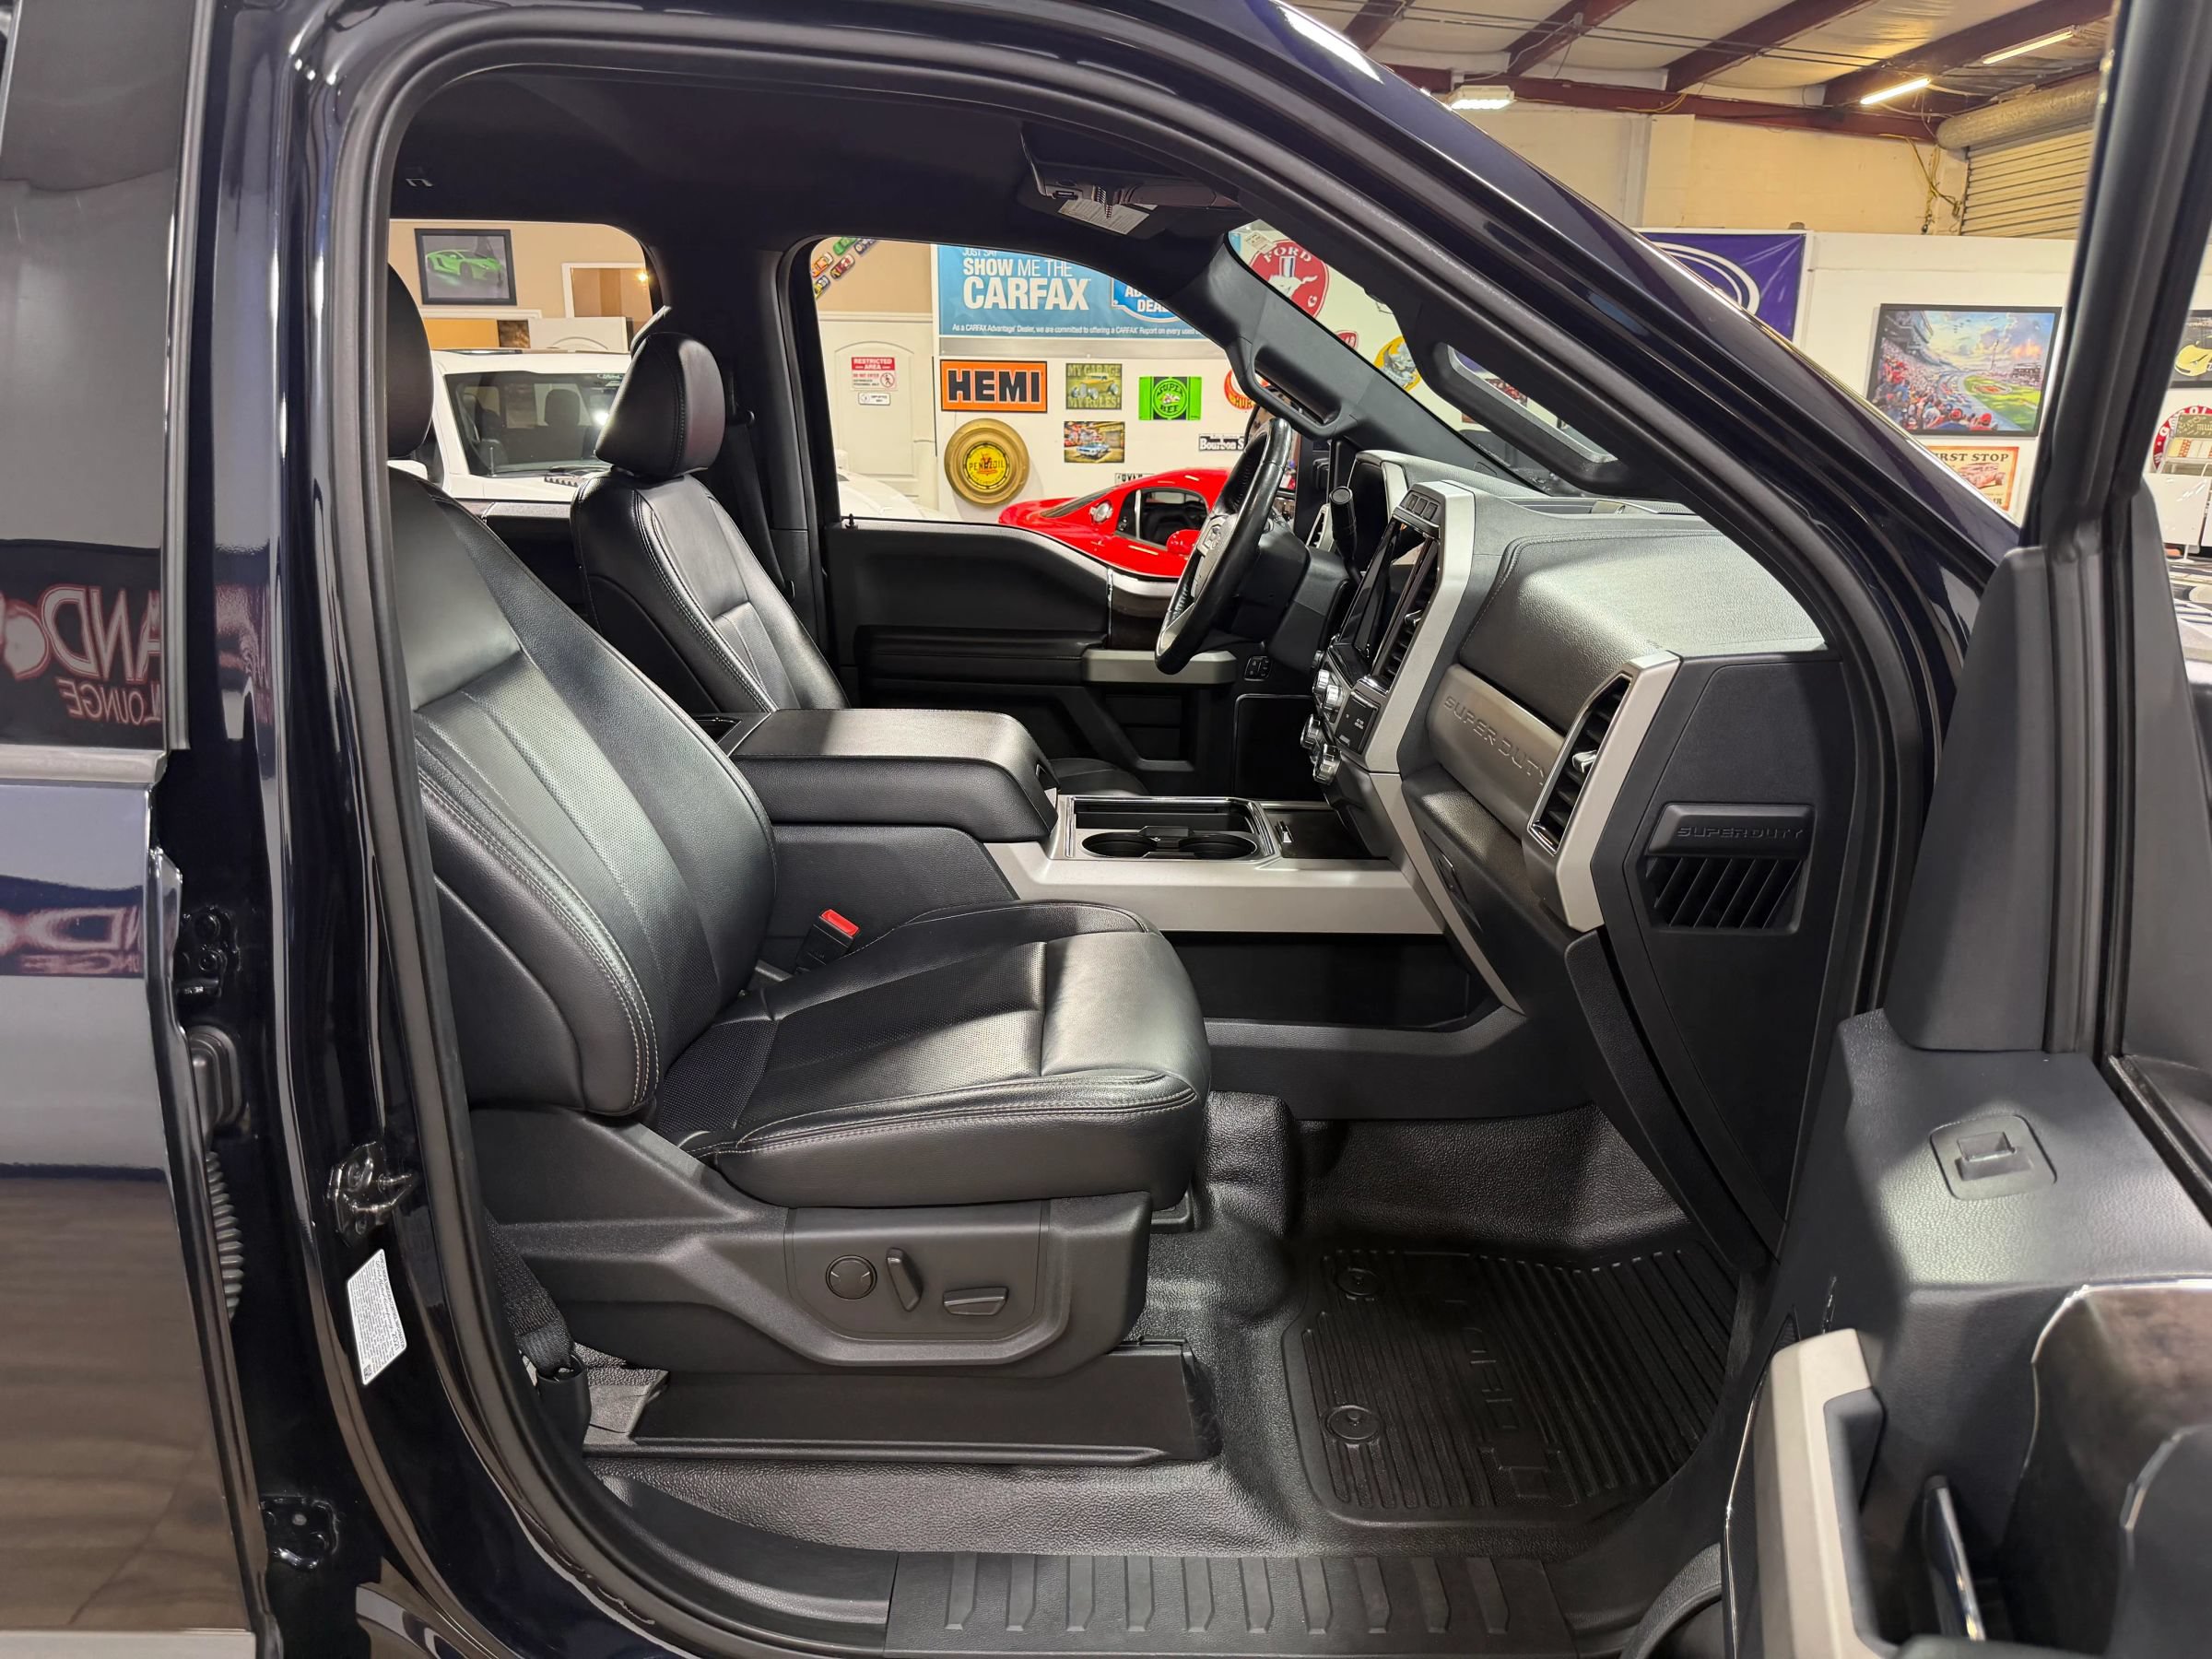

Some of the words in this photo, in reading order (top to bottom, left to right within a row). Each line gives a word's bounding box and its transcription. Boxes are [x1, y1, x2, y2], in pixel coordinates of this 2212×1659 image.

[1263, 246, 1312, 263] FORD
[962, 258, 1014, 276] SHOW
[1017, 259, 1041, 277] ME
[1044, 260, 1074, 277] THE
[962, 277, 1089, 312] CARFAX
[965, 324, 987, 333] CARFAX
[1089, 327, 1110, 336] offering
[1166, 329, 1181, 337] every
[1067, 365, 1081, 377] MY
[1084, 365, 1121, 378] GARAGE
[947, 369, 1041, 403] HEMI
[1157, 382, 1183, 397] SUPER
[1067, 395, 1085, 408] MY
[1087, 394, 1121, 408] RULES!
[1159, 405, 1179, 414] BEE
[1199, 437, 1237, 451] Bourbon
[1971, 453, 2009, 462] STOP
[1442, 695, 1498, 747] SUPER
[1497, 736, 1547, 787] DUTY
[392, 1330, 400, 1352] 2021
